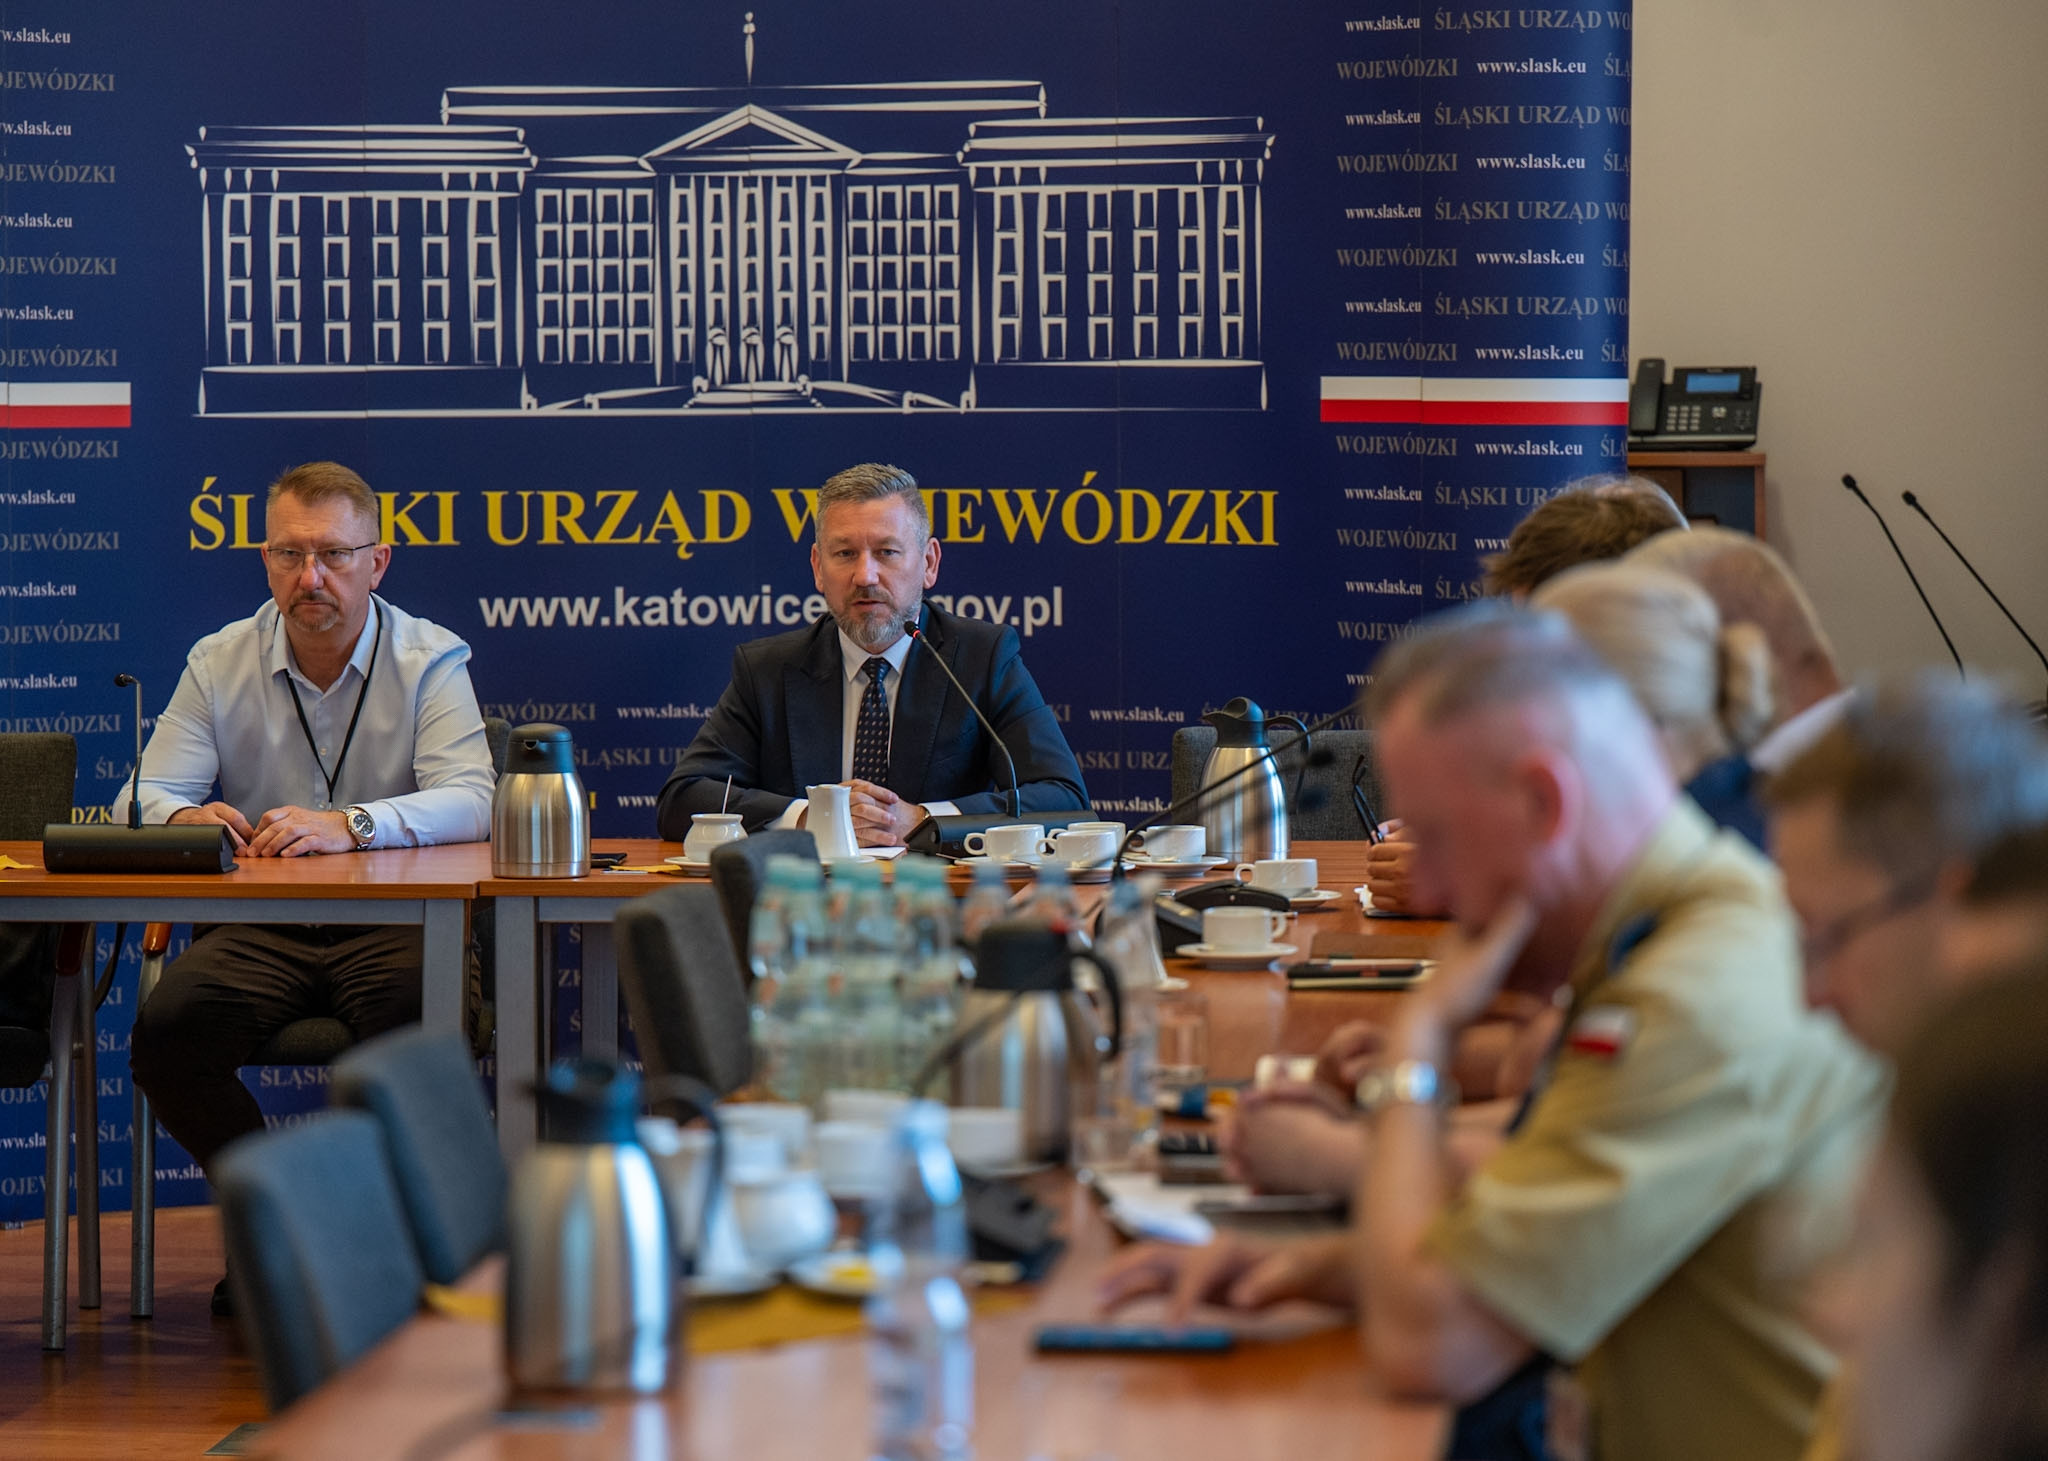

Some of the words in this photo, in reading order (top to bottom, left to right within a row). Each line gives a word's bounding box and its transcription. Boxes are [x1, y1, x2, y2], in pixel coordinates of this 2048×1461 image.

[1345, 15, 1420, 32] www.slask.eu
[1434, 8, 1510, 34] ŚLĄSKI
[1519, 10, 1602, 33] URZĄD
[0, 28, 70, 43] w.slask.eu
[0, 67, 115, 91] JEWÓDZKI
[1336, 54, 1458, 80] WOJEWÓDZKI
[1477, 58, 1587, 73] www.slask.eu
[1345, 109, 1420, 125] www.slask.eu
[1434, 102, 1510, 129] ŚLĄSKI
[1518, 105, 1600, 129] URZĄD
[1336, 148, 1458, 174] WOJEWÓDZKI
[1476, 153, 1586, 169] www.slask.eu
[1345, 203, 1421, 219] www.slask.eu
[1434, 196, 1509, 225] ŚLĄSKI
[1517, 201, 1600, 225] URZĄD
[1337, 243, 1457, 267] WOJEWÓDZKI
[1475, 249, 1585, 264] www.slask.eu
[1345, 297, 1421, 313] www.slask.eu
[1435, 291, 1508, 320] ŚLĄSKI
[1516, 296, 1599, 320] URZĄD
[1336, 337, 1457, 361] WOJEWÓDZKI
[1475, 345, 1584, 360] www.slask.eu
[1336, 431, 1457, 456] WOJEWÓDZKI
[1475, 440, 1583, 455] www.slask.eu
[1344, 485, 1421, 501] www.slask.eu
[1435, 481, 1507, 510] ŚLĄSKI
[190, 477, 460, 550] ŚLKI
[481, 490, 751, 560] URZĄD
[771, 472, 1279, 547] WJEWÓDZKI
[1336, 525, 1456, 551] WOJEWÓDZKI
[1345, 579, 1422, 595] www.slask.eu
[1089, 706, 1185, 722] www.slask.eu
[1127, 751, 1171, 770] URZ
